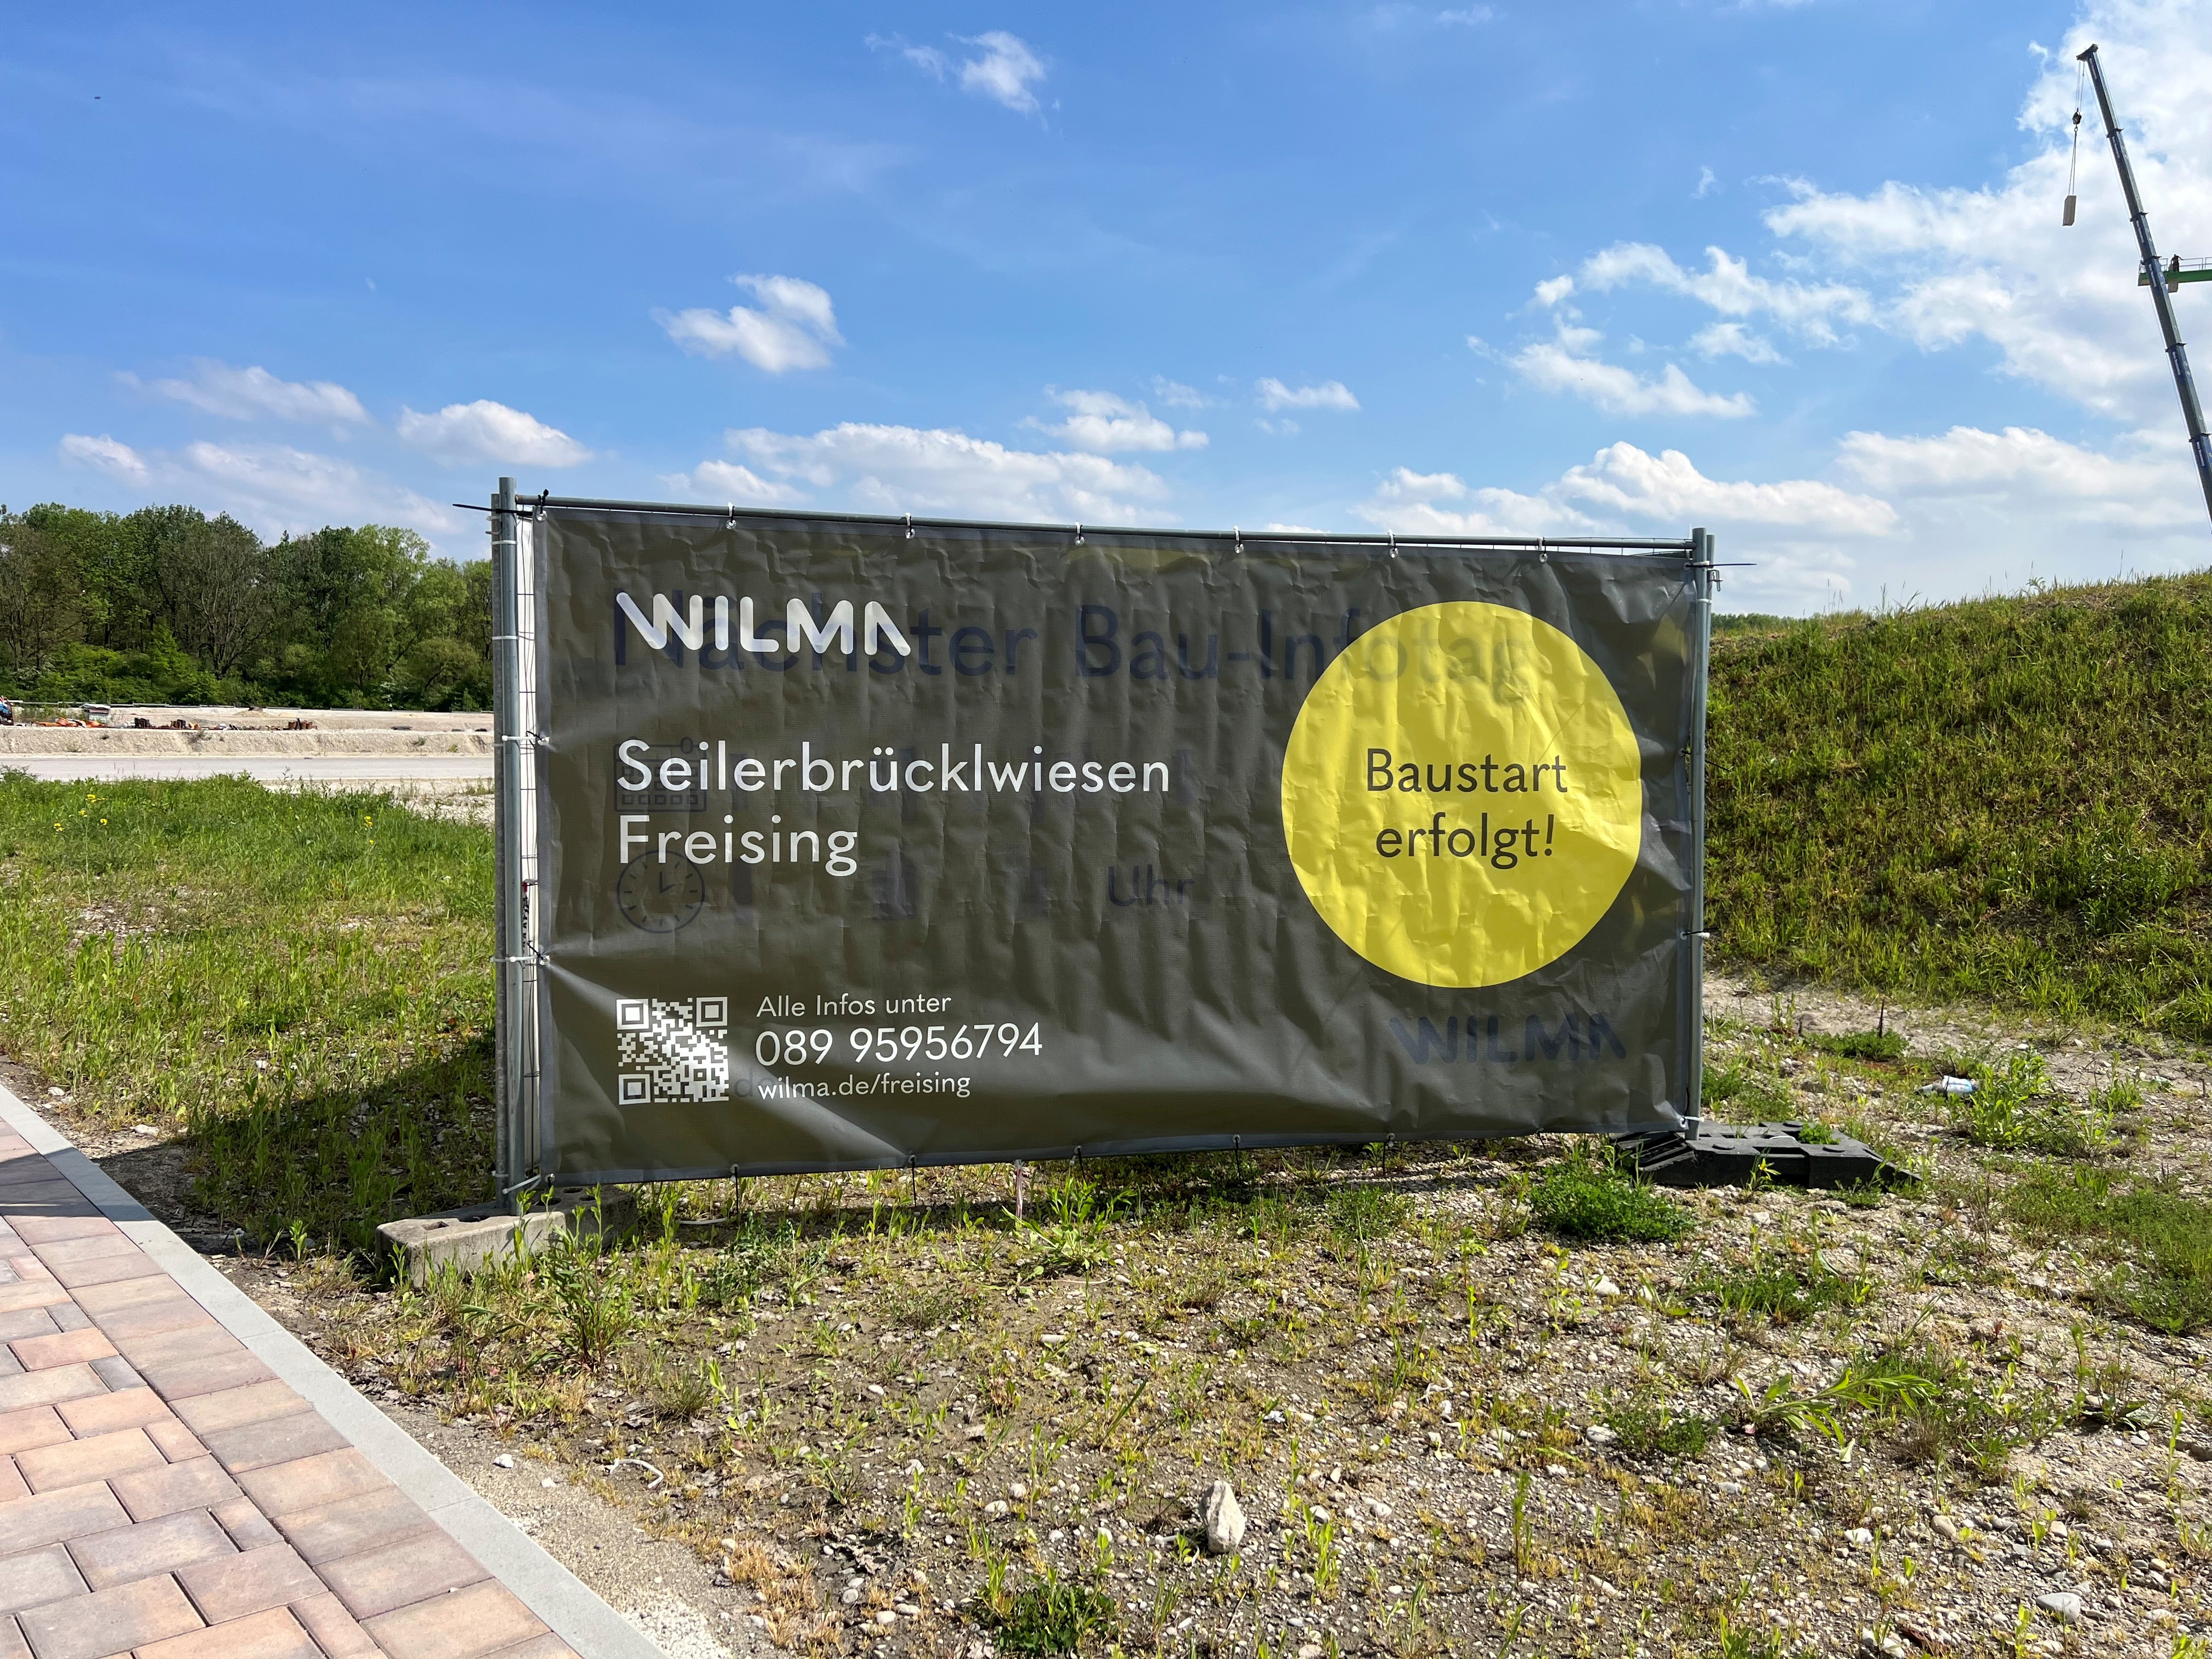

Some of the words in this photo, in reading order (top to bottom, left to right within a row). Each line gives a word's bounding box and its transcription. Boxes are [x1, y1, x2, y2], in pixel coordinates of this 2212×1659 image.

[616, 591, 912, 657] WILMA
[617, 739, 1169, 793] Seilerbrücklwiesen
[1367, 748, 1567, 793] Baustart
[619, 814, 858, 877] Freising
[1376, 812, 1555, 870] erfolgt!
[755, 995, 806, 1018] Alle
[816, 992, 876, 1016] Infos
[885, 993, 952, 1014] unter
[755, 1028, 833, 1066] 089
[849, 1022, 1043, 1064] 95956794
[758, 1070, 972, 1099] wilma.de/freising
